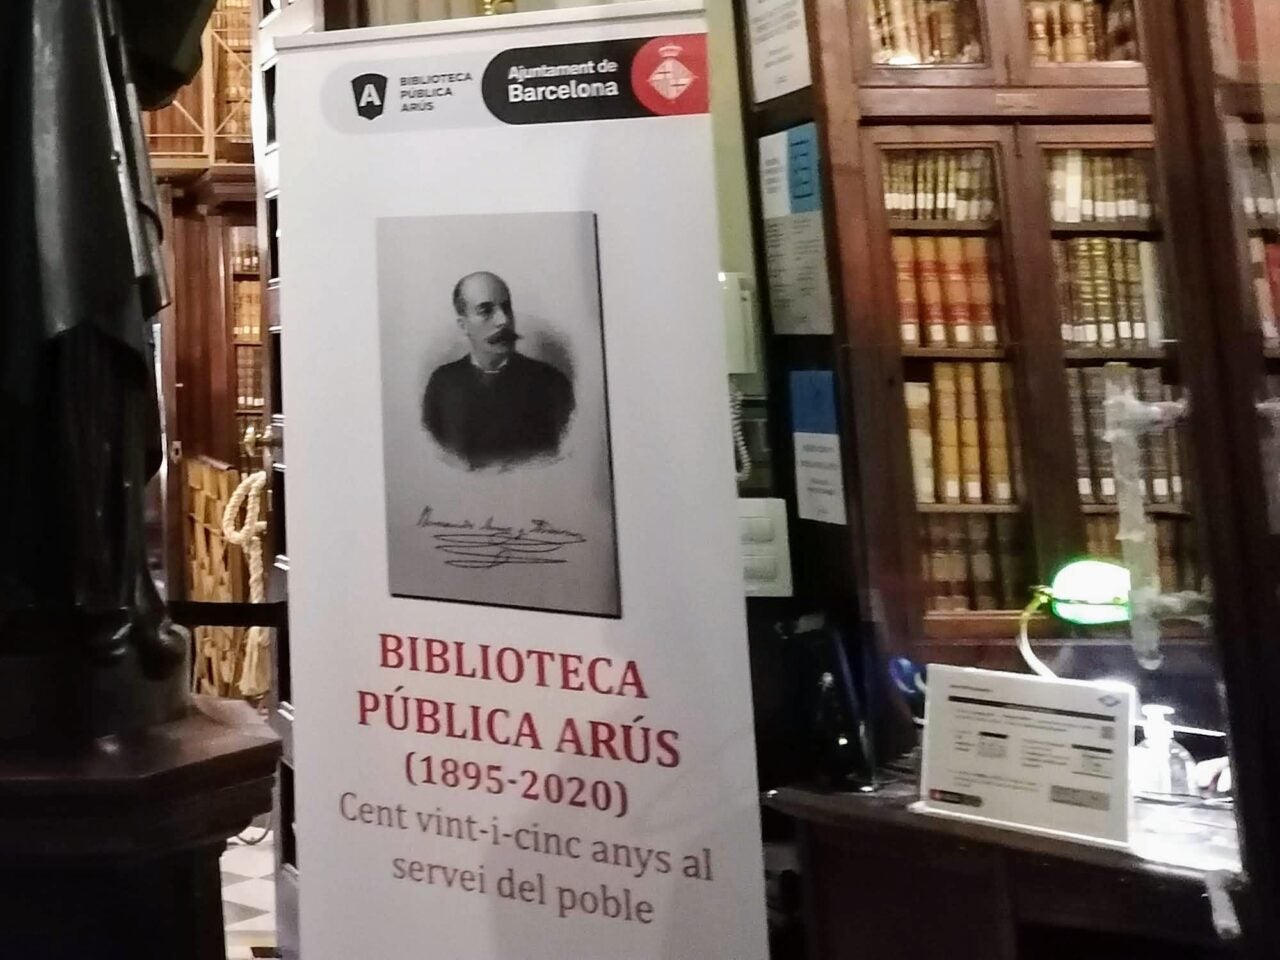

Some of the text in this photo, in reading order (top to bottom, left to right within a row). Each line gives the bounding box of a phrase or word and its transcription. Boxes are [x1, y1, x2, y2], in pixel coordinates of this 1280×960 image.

[399, 71, 473, 87] BIBLIOTECA
[508, 58, 619, 82] Ajuntament de
[358, 83, 383, 107] A
[400, 85, 453, 99] PÚBLICA
[507, 79, 619, 103] Barcelona
[401, 99, 435, 113] ARÚS
[378, 632, 650, 700] BIBLIOTECA
[356, 685, 681, 769] PÚBLICA ARÚS
[404, 751, 630, 819] (1895-2020)
[339, 791, 715, 882] Cent vint-i-cinc anys al
[391, 855, 656, 925] servei del poble
